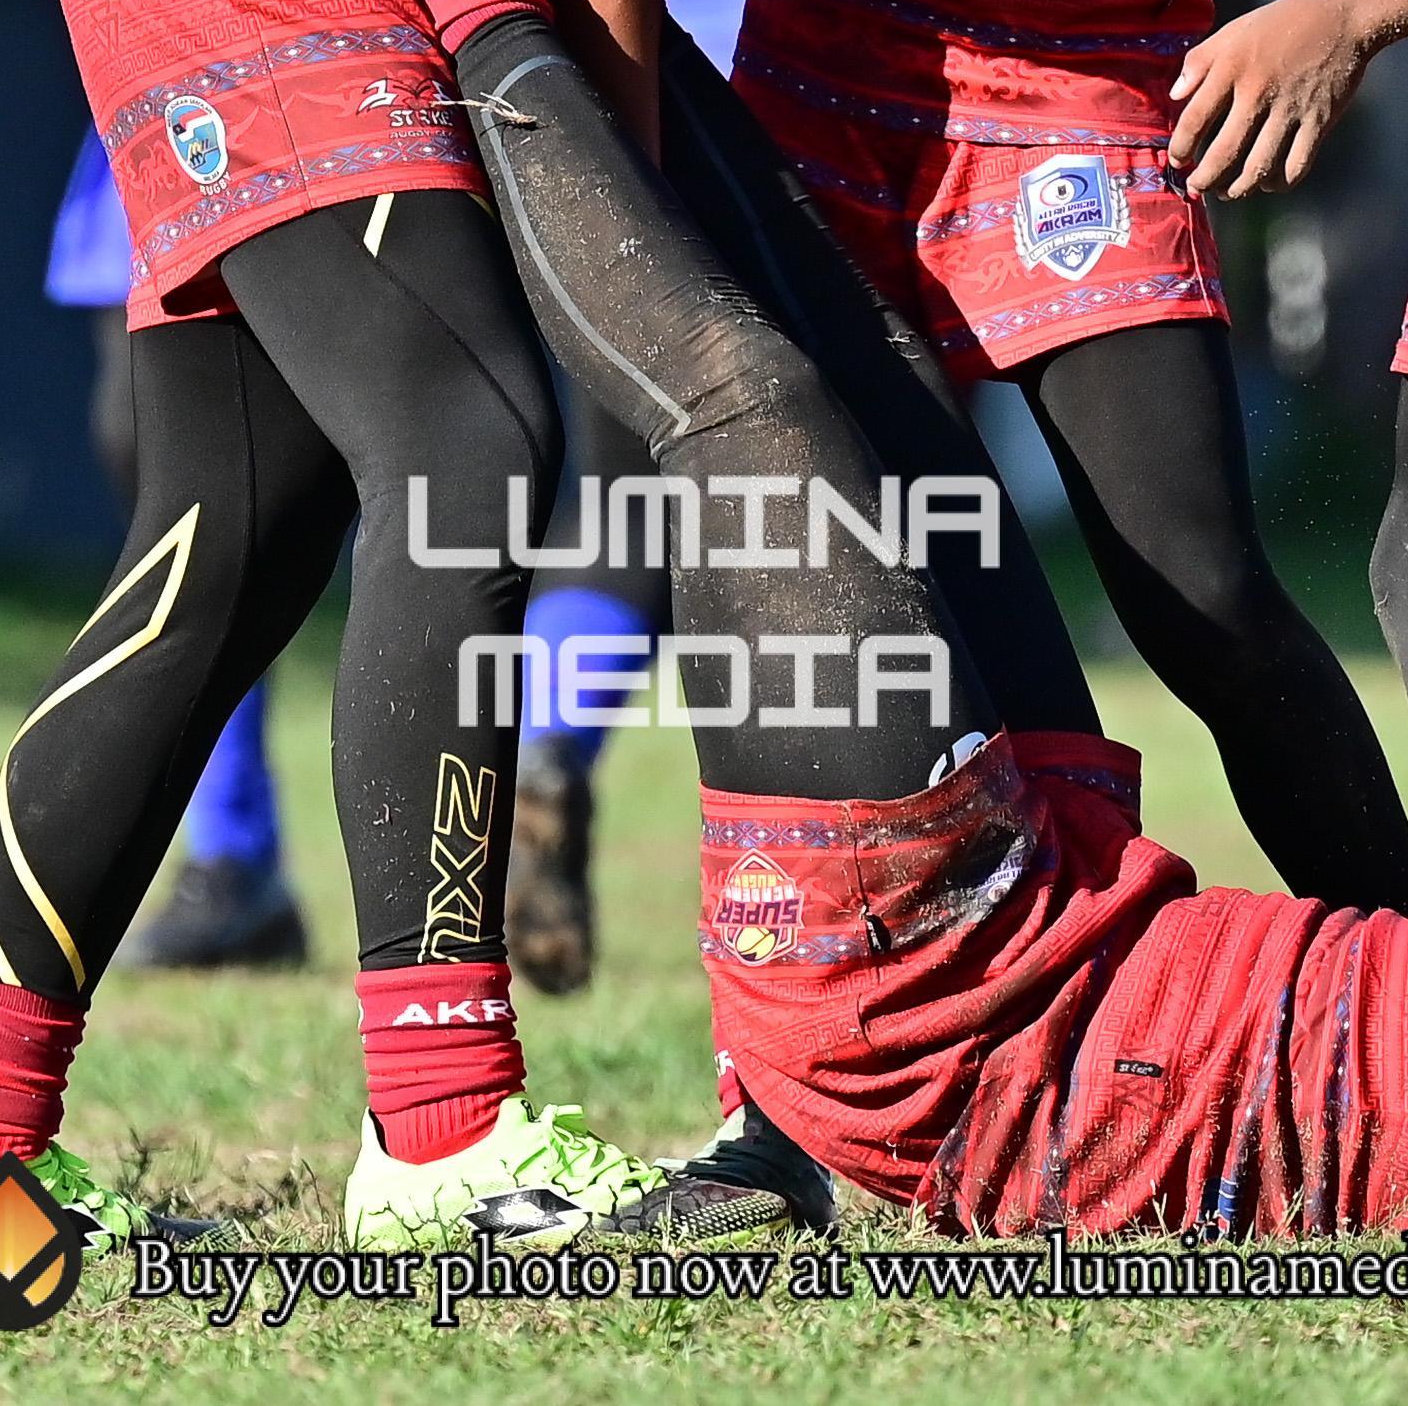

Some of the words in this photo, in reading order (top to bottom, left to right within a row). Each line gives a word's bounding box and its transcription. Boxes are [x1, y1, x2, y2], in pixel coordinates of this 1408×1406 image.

[199, 170, 232, 196] RUGBY
[1037, 208, 1103, 235] AKRAM
[715, 898, 800, 925] SUPER
[392, 999, 513, 1026] AKR
